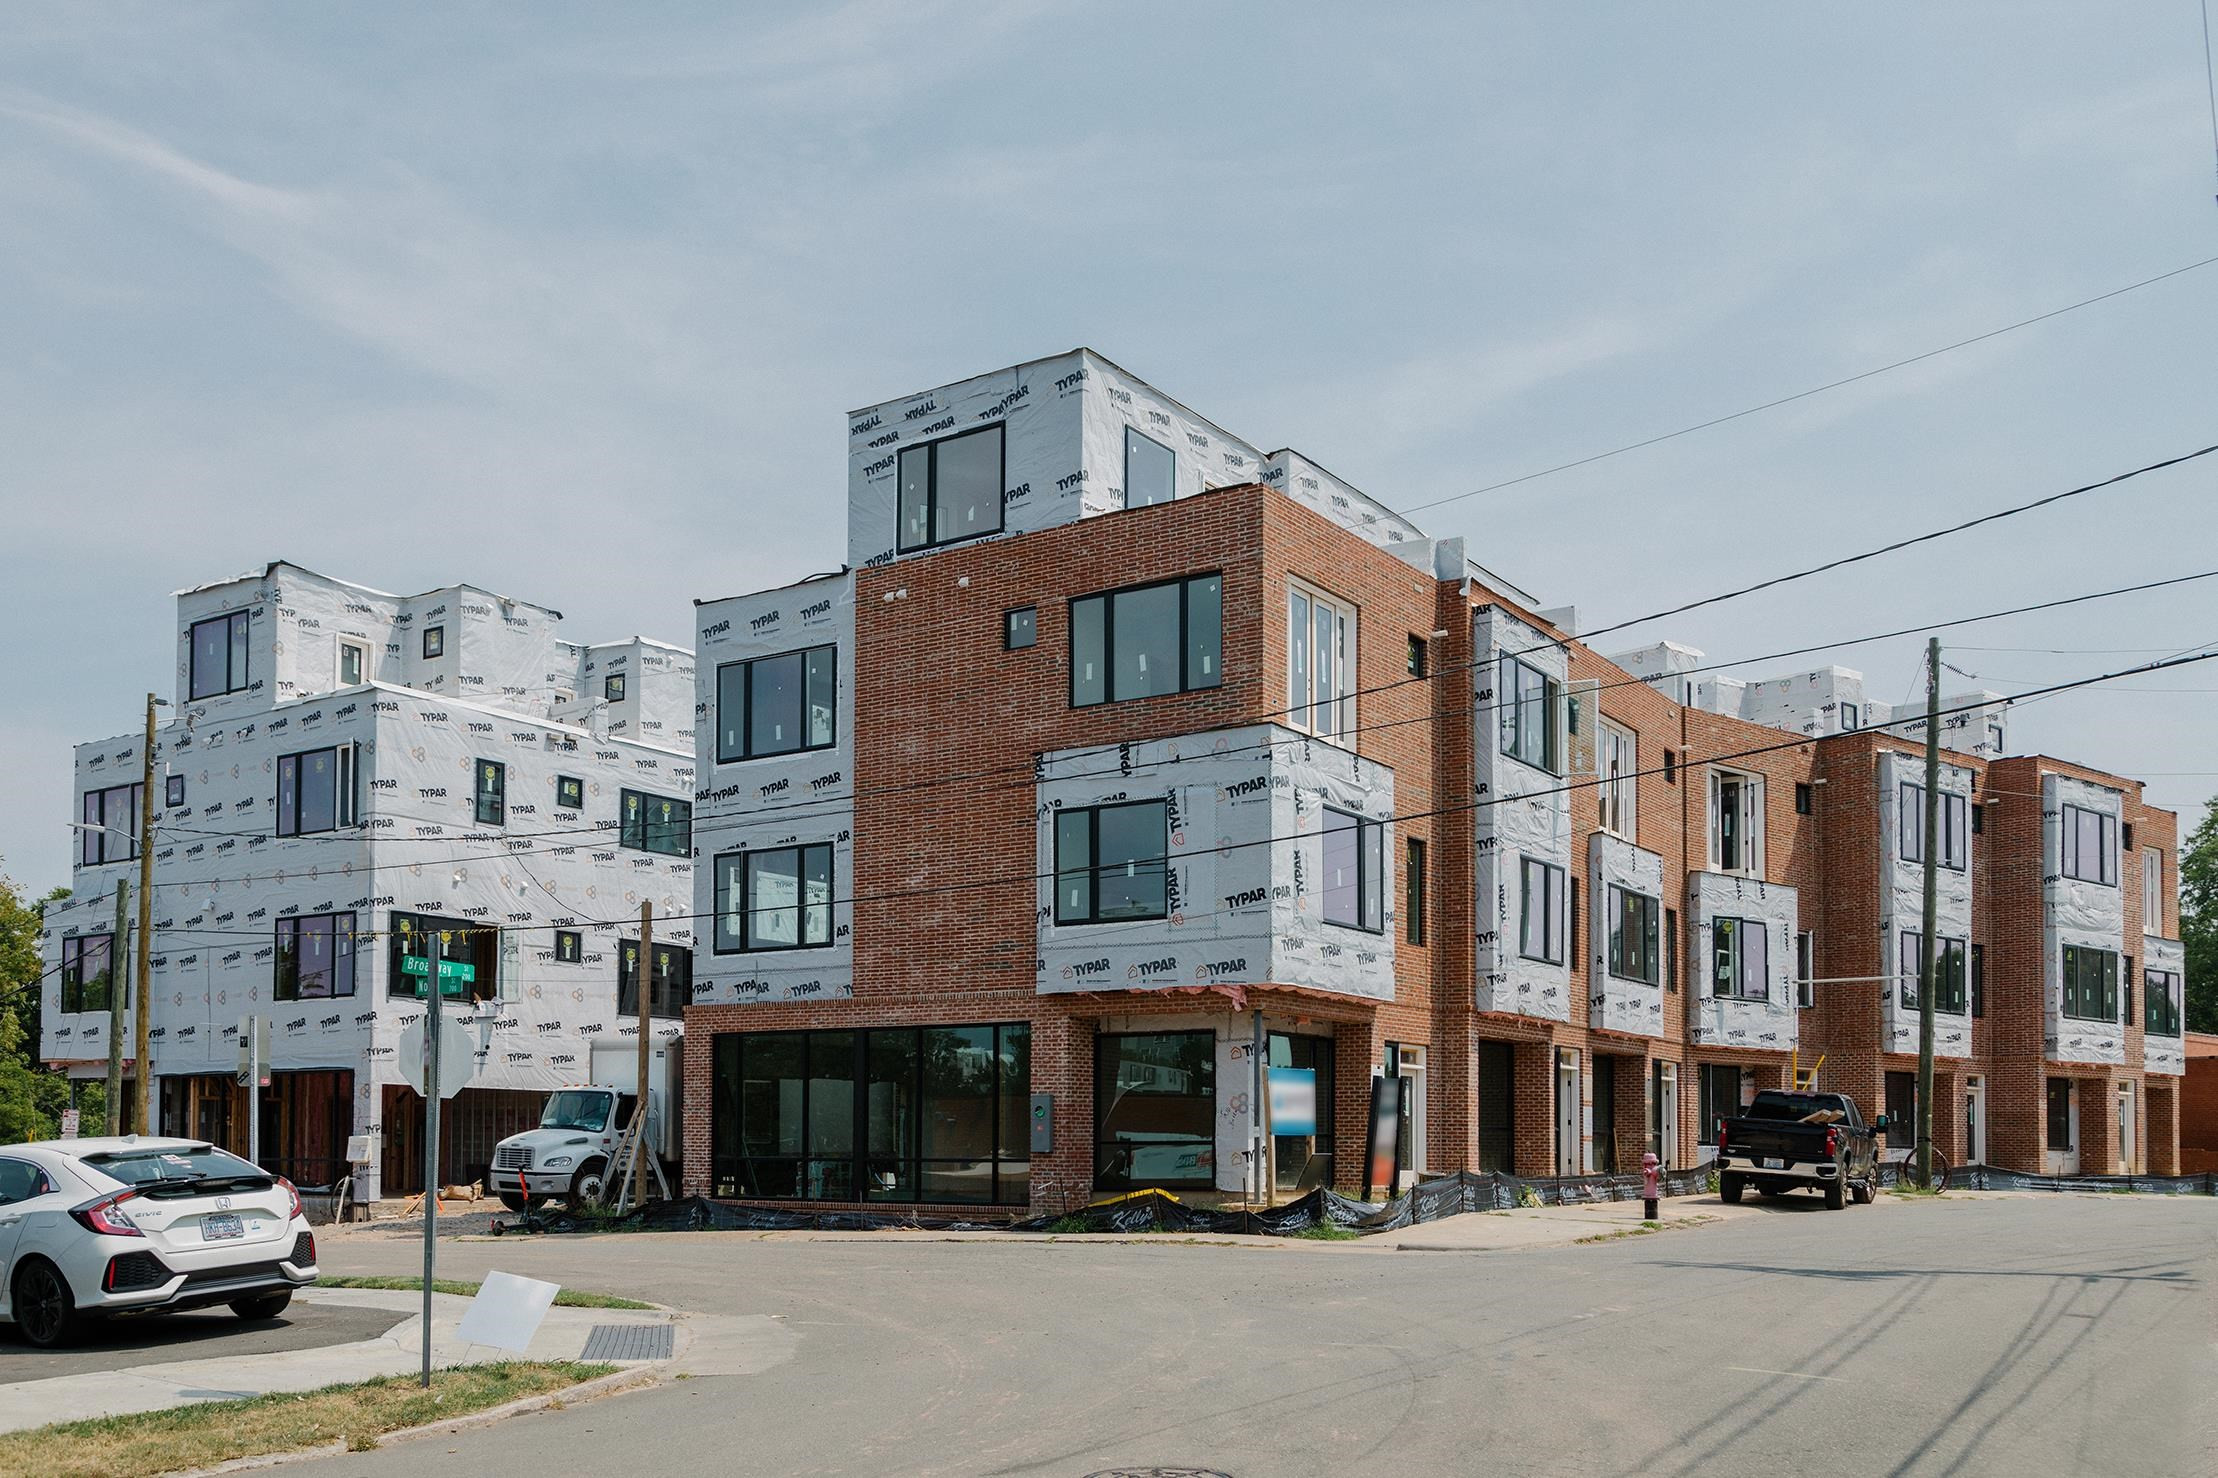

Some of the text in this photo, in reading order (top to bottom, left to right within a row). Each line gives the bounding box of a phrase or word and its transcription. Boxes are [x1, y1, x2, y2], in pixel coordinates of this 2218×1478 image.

[1055, 368, 1090, 391] TYPAR
[1000, 385, 1030, 410] YPAR
[1109, 387, 1132, 404] TYPAR
[905, 400, 937, 420] TYPAR
[1149, 410, 1170, 426] TYPAR
[922, 416, 956, 435] TYPAR
[1187, 433, 1208, 448] TYPAR
[863, 455, 895, 477] TYPAR
[1223, 453, 1243, 467] TYPAR
[1056, 470, 1090, 491] TYPAR
[1257, 467, 1283, 483] TYPAR
[1299, 476, 1318, 490] TYPAR
[1004, 482, 1031, 503] YPAR
[426, 605, 446, 620] TYPAR
[461, 606, 487, 615] TYPAR
[800, 599, 831, 619] TYPAR
[298, 618, 320, 629] YPAR
[390, 612, 412, 624] TYPAR
[504, 617, 528, 628] TYPAR
[750, 610, 780, 629] TYPAR
[702, 620, 730, 639] TYPAR
[608, 656, 627, 669] TYPAR
[642, 656, 664, 666] TYPAR
[459, 676, 484, 685] TYPAR
[1641, 672, 1663, 684] PAR
[503, 687, 526, 696] TYPAR
[1474, 689, 1493, 702] PAR
[336, 704, 356, 720] TYPAR
[371, 702, 399, 712] TYPAR
[1819, 702, 1837, 714] PAR
[302, 710, 321, 726] TYPAR
[421, 712, 448, 722] TYPAR
[269, 718, 288, 732] TYPAR
[469, 723, 493, 733] TYPAR
[608, 720, 627, 733] TYPAR
[642, 721, 662, 730] TYPAR
[1904, 720, 1927, 733] TYPAR
[512, 733, 536, 743] TYPAR
[555, 742, 578, 752] TYPAR
[89, 754, 105, 768] TYPAR
[116, 749, 133, 762] TYPAR
[596, 751, 619, 761] TYPAR
[1120, 742, 1131, 777] YPAR
[636, 760, 658, 769] TYPAR
[673, 768, 694, 777] TYPAR
[370, 780, 397, 790] TYPAR
[760, 778, 789, 796] TYPAR
[811, 772, 841, 790] TYPAR
[1226, 776, 1267, 799] TYPAR
[1270, 775, 1290, 789] YPAR
[420, 788, 447, 798] TYPAR
[711, 784, 739, 802] TYPAR
[205, 802, 222, 817] TYPAR
[235, 798, 254, 812] TYPAR
[511, 805, 536, 815] TYPAR
[174, 808, 191, 821] TYPAR
[554, 812, 578, 822] TYPAR
[371, 818, 394, 829] YPAR
[596, 820, 618, 829] TYPAR
[416, 825, 443, 836] TYPAR
[216, 839, 235, 853] TYPAR
[248, 834, 266, 849] TYPAR
[508, 840, 533, 849] TYPAR
[156, 849, 174, 862] TYPAR
[186, 844, 204, 858] TYPAR
[551, 847, 575, 855] TYPAR
[592, 852, 615, 862] TYPAR
[632, 858, 654, 868] TYPAR
[1295, 850, 1304, 896] TYPAR
[1168, 867, 1181, 914] TYPAR
[1272, 886, 1291, 899] YPAR
[370, 896, 394, 907] YPAR
[1225, 888, 1267, 909] TYPAR
[280, 904, 299, 915] TYPAR
[313, 901, 333, 912] TYPAR
[415, 902, 442, 912] TYPAR
[463, 907, 488, 917] TYPAR
[216, 911, 234, 926] TYPAR
[248, 908, 266, 922] TYPAR
[508, 912, 532, 922] TYPAR
[551, 917, 575, 926] TYPAR
[186, 915, 203, 929] TYPAR
[670, 930, 690, 940] TYPAR
[1281, 938, 1304, 951] TYPAR
[1320, 944, 1342, 958] TYPAR
[222, 951, 241, 965] TYPAR
[254, 946, 272, 961] TYPAR
[582, 953, 602, 964] YPAR
[1356, 952, 1377, 964] TYPAR
[150, 956, 167, 968] YPAR
[179, 954, 197, 968] TYPAR
[407, 957, 452, 976] Broaay
[1073, 958, 1111, 976] TYPAR
[1138, 957, 1177, 975] TYPAR
[1207, 958, 1247, 976] TYPAR
[692, 980, 713, 995] YPAR
[734, 979, 756, 993] TYPA
[791, 980, 821, 997] TYPAR
[1518, 983, 1531, 994] YPAR
[287, 1018, 306, 1031] TYPAR
[320, 1015, 340, 1028] TYPAR
[355, 1011, 378, 1025] TYPAR
[493, 1018, 518, 1030] TYPAR
[55, 1026, 71, 1039] TYPAR
[82, 1026, 99, 1039] TYPAR
[178, 1026, 196, 1038] TYPAR
[222, 1025, 238, 1038] TYPA
[538, 1022, 561, 1033] TYPAR
[579, 1024, 602, 1034] TYPAR
[551, 1055, 575, 1065] TYPAR
[1112, 1206, 1153, 1230] Kelly's
